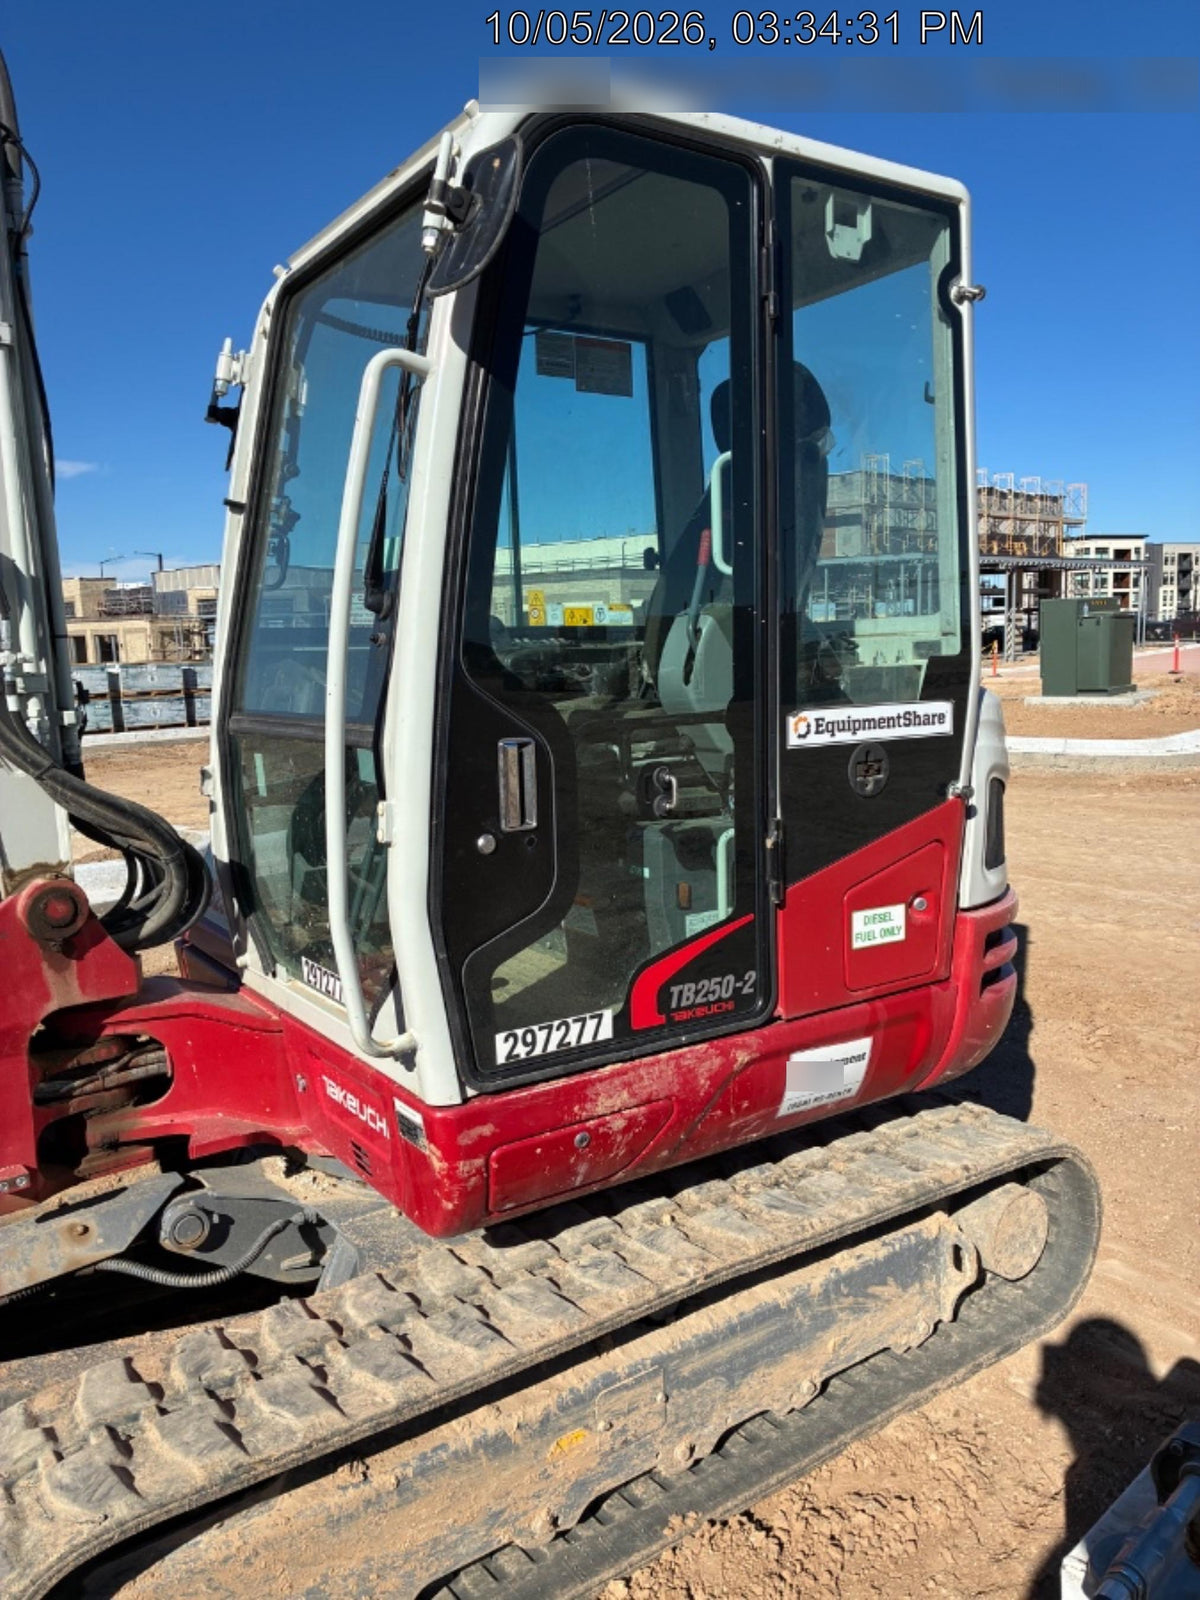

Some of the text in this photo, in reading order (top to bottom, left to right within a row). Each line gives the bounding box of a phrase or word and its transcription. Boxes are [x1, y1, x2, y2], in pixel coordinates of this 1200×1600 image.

[814, 710, 946, 738] EquipmentShare
[863, 911, 894, 926] DIESEL
[855, 924, 902, 943] FUEL ONLY
[669, 969, 757, 1009] TB250-2
[503, 1012, 604, 1062] 297277
